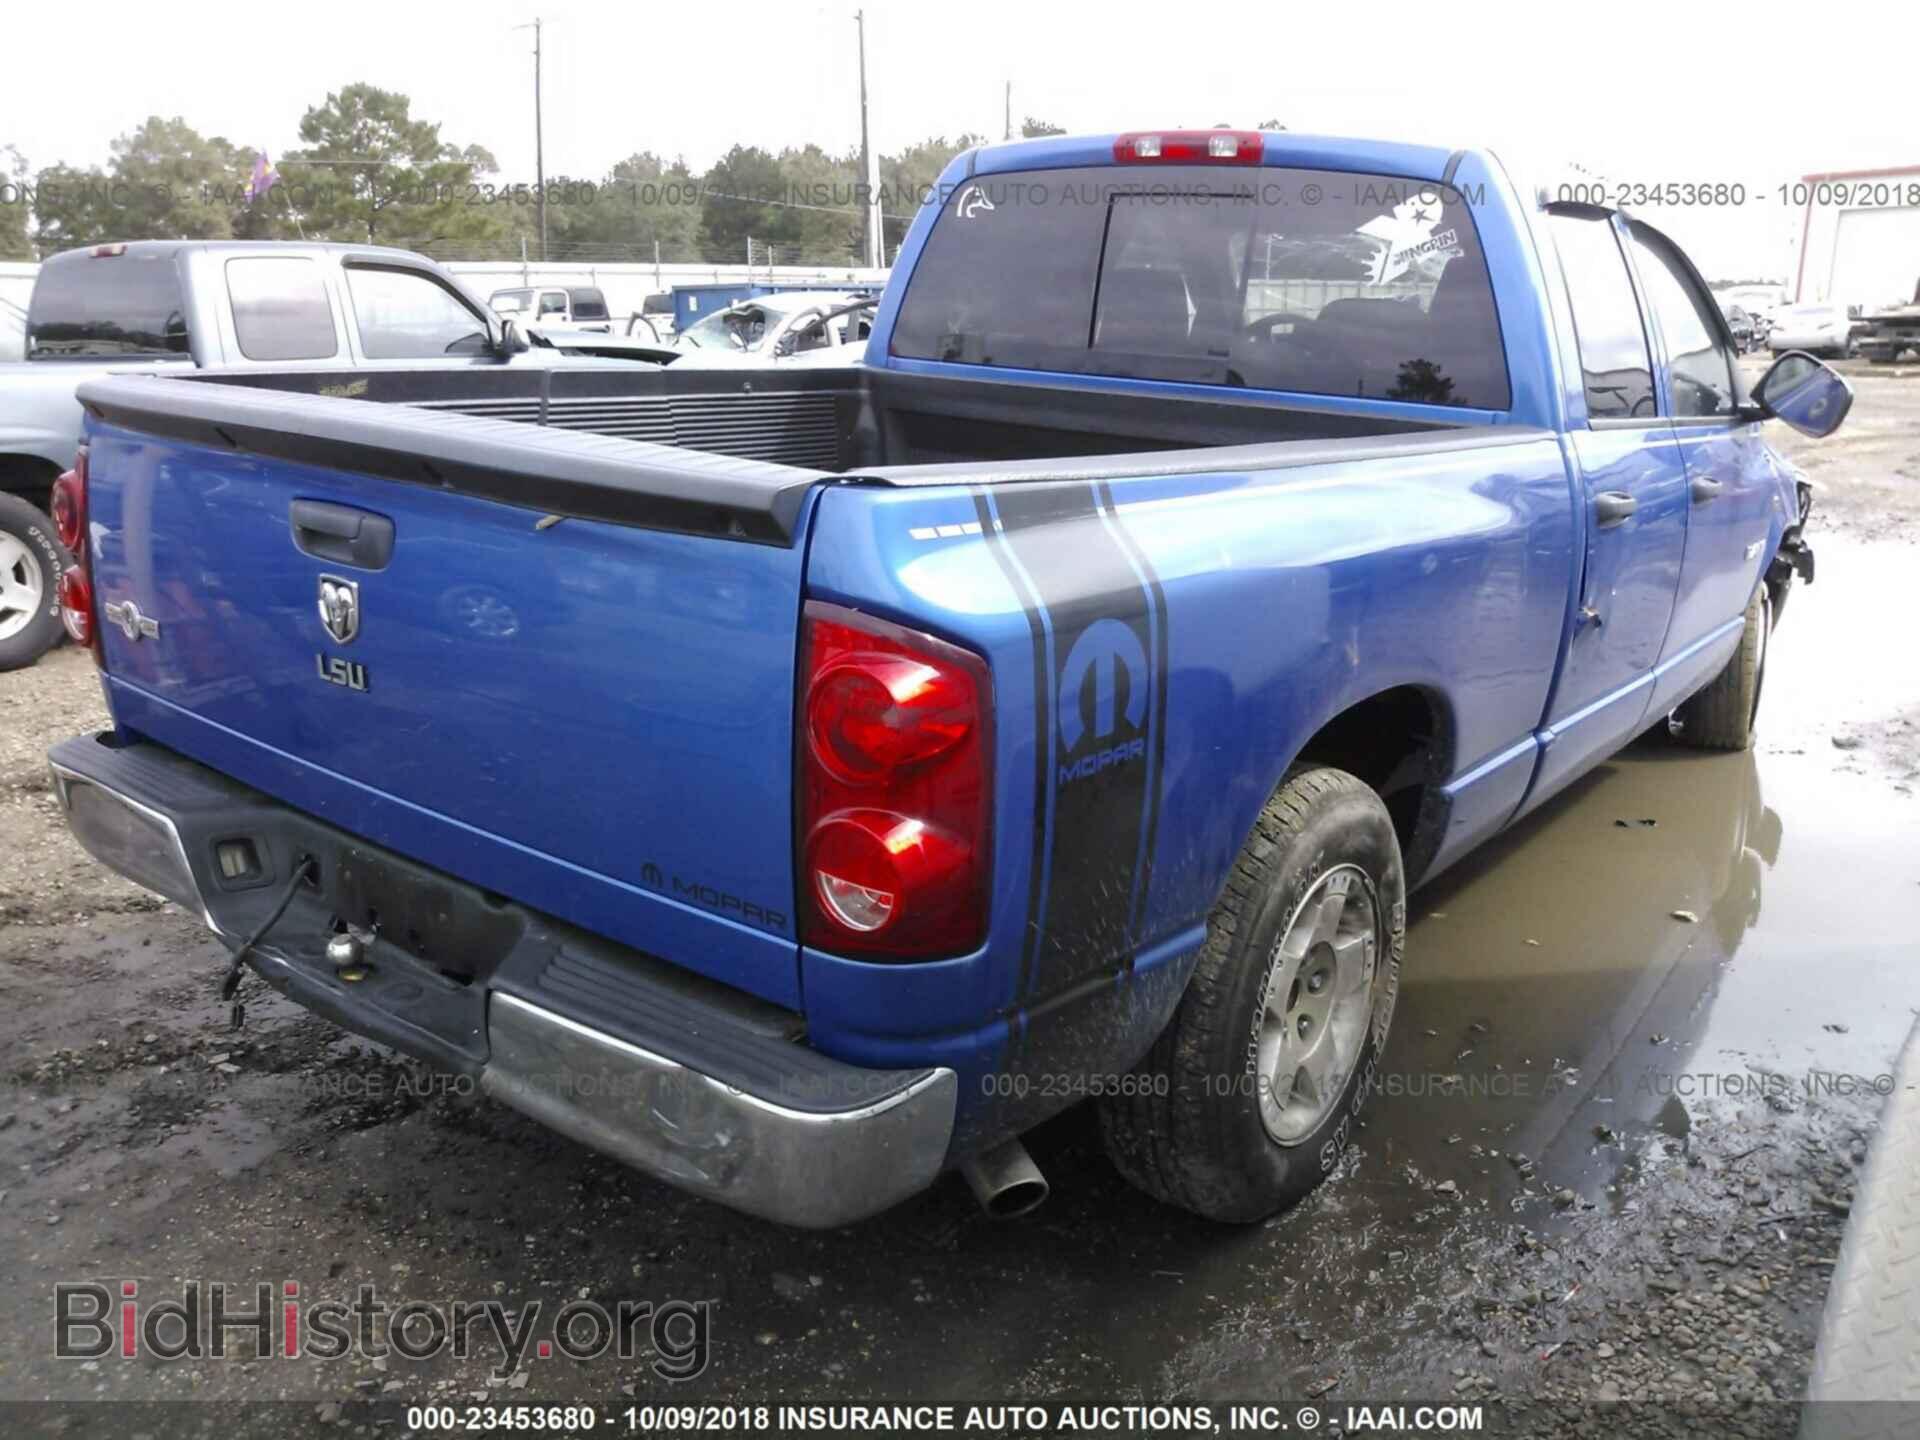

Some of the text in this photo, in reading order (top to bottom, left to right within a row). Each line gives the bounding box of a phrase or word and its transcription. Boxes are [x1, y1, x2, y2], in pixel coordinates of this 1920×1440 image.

[316, 653, 369, 692] LSU
[1060, 739, 1145, 784] MOPAR
[672, 876, 787, 929] MOPAR
